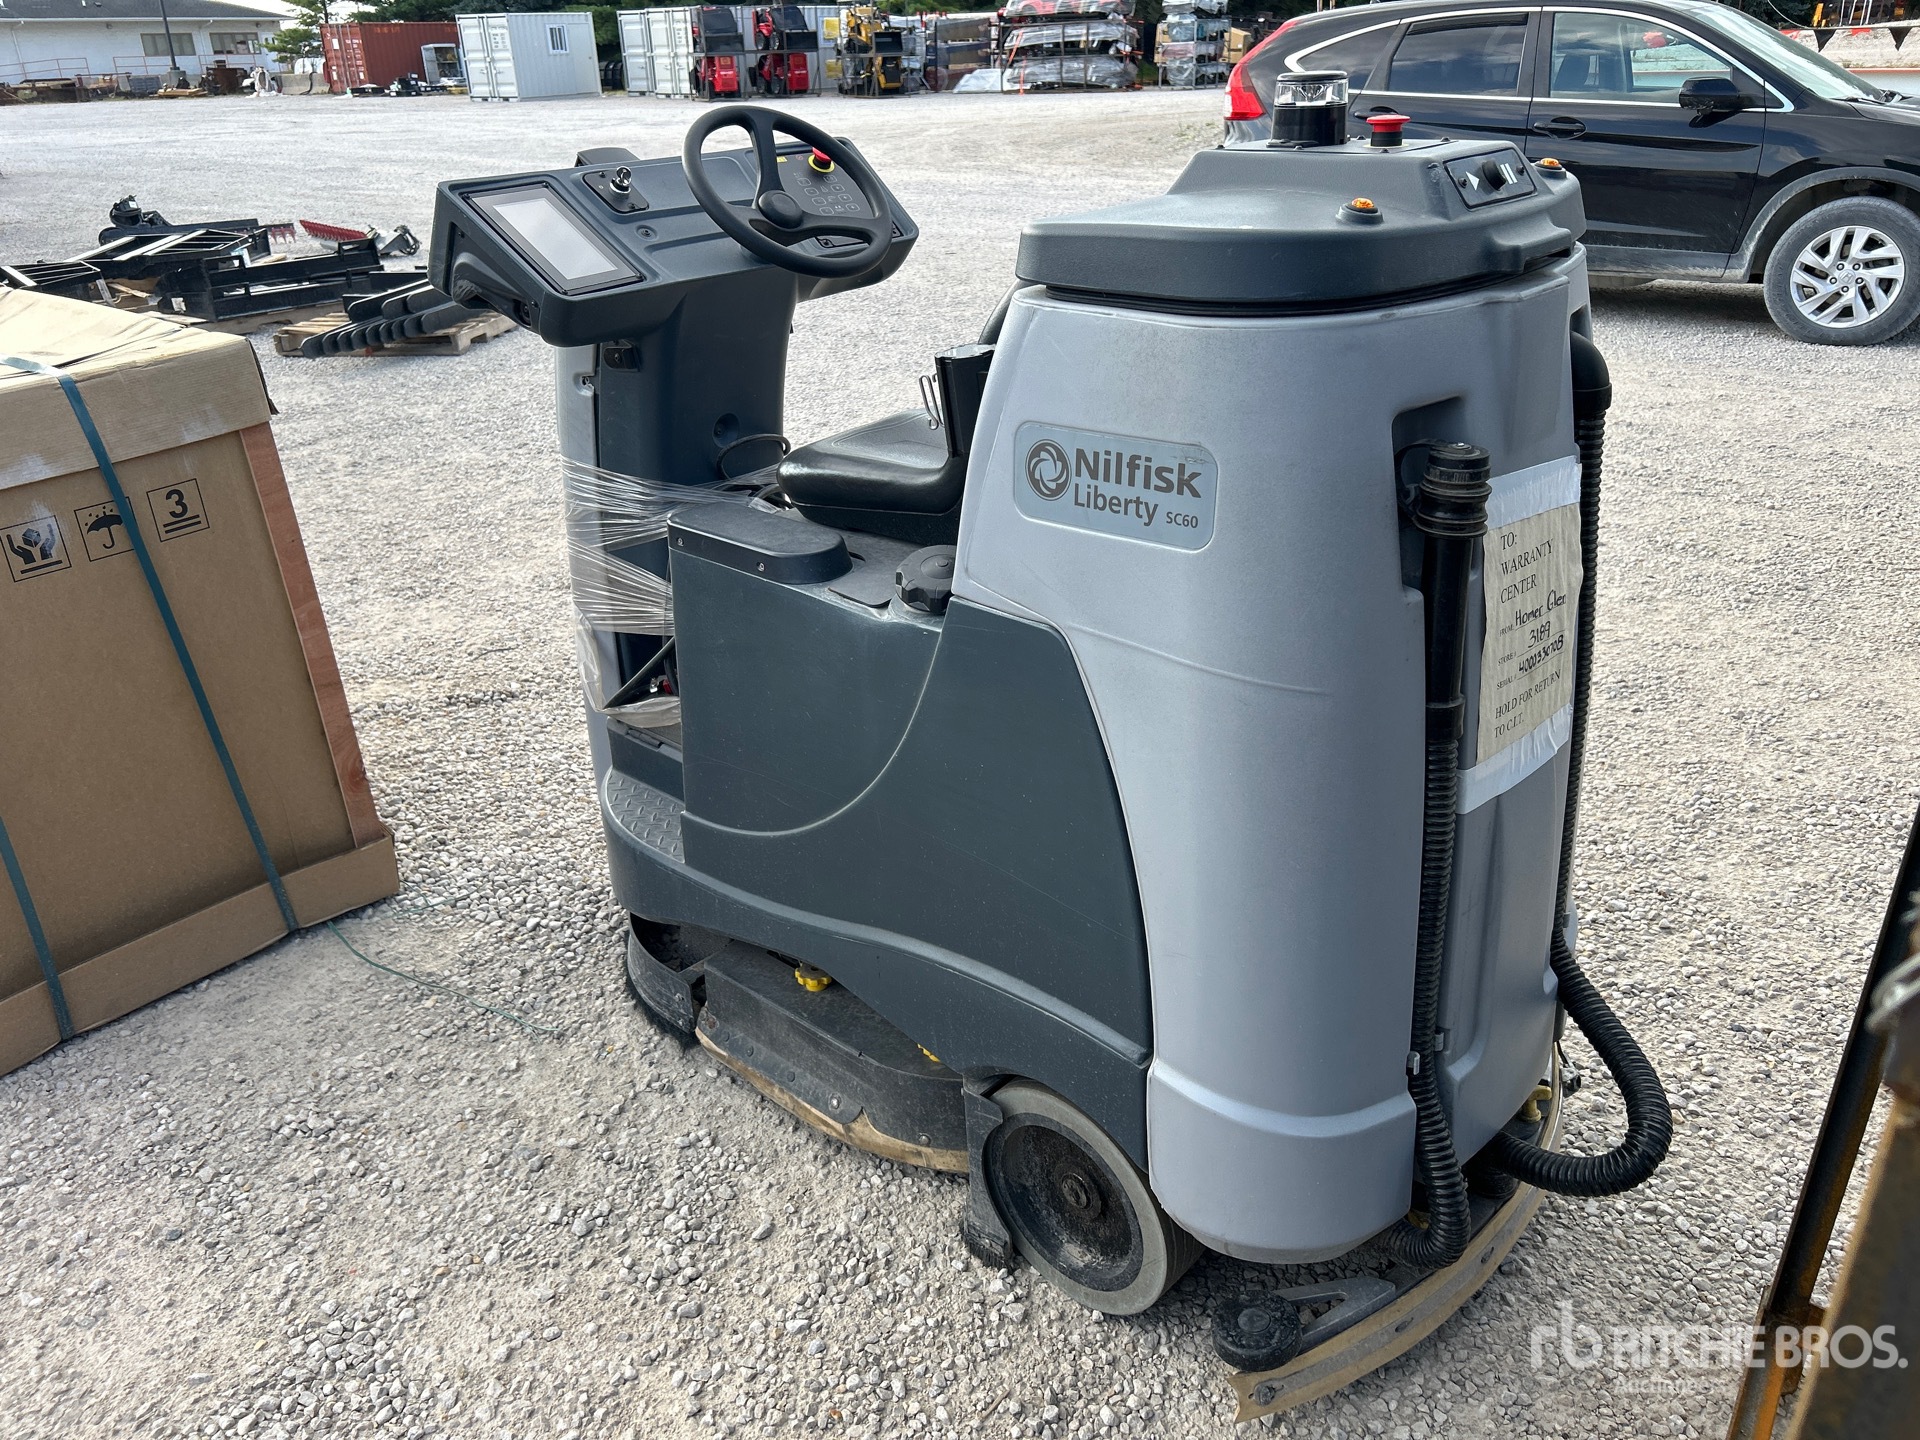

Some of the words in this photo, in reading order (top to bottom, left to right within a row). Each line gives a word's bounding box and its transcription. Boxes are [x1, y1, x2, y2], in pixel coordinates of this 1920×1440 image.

[1075, 448, 1202, 498] Nilfisk
[165, 489, 188, 519] 3
[1074, 483, 1159, 527] Liberty
[1166, 511, 1199, 529] SC60
[1500, 532, 1517, 550] TO:
[1500, 538, 1553, 576] WARRANTY
[1500, 574, 1537, 604] CENTER
[1515, 605, 1543, 626] Homer
[1528, 621, 1551, 648] 3189
[1495, 697, 1517, 719] HOLD
[1519, 688, 1533, 705] FOR
[1494, 723, 1505, 738] TO
